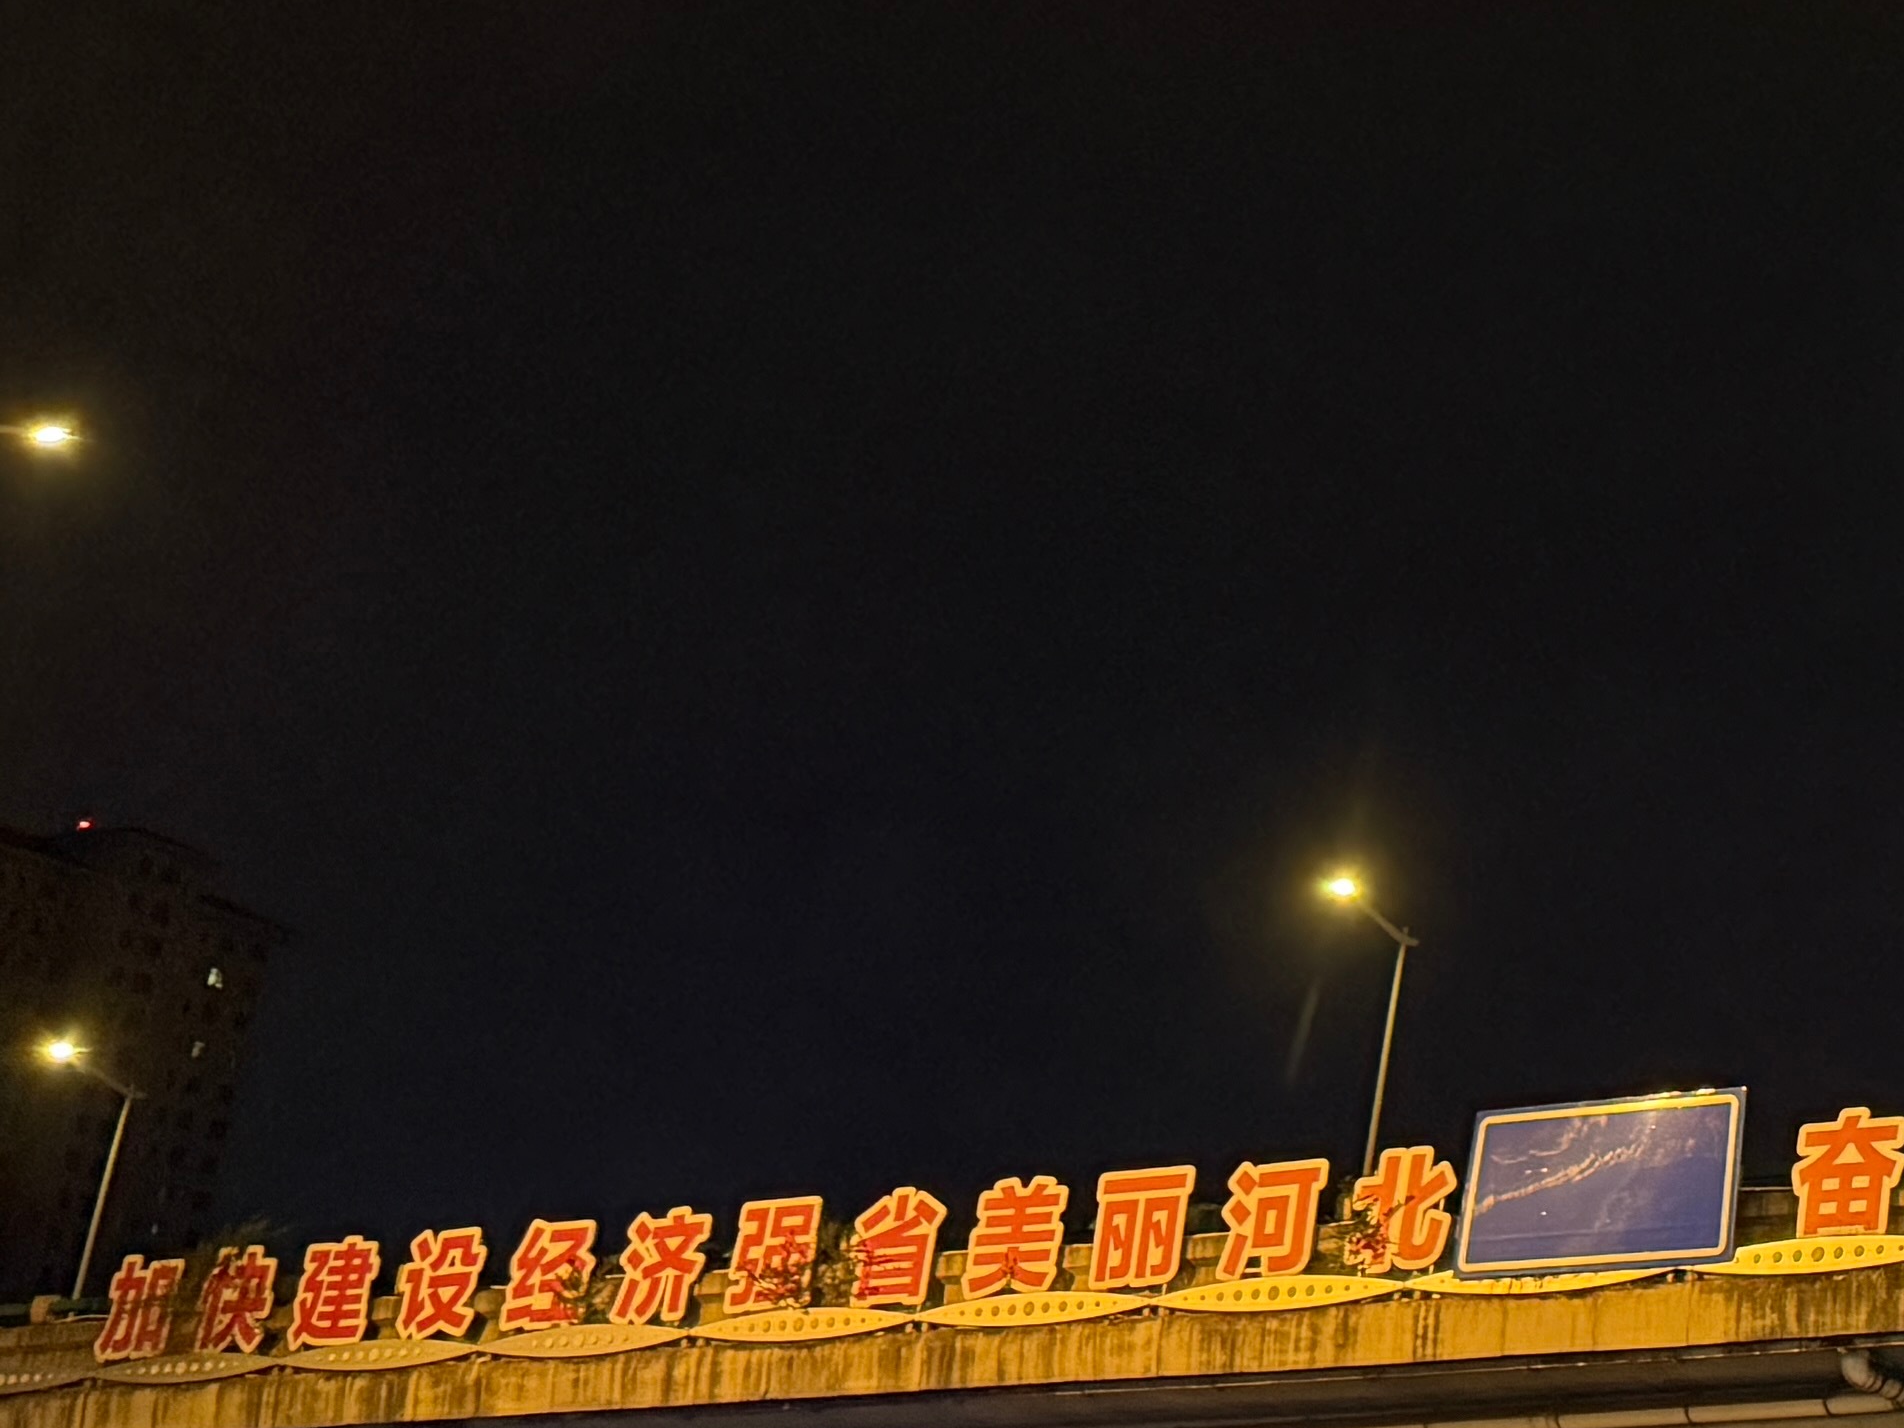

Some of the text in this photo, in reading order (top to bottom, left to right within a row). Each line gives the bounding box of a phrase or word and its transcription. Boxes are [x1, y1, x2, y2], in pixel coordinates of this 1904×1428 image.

[95, 1146, 1455, 1360] 加快建设经济强省美丽河北
